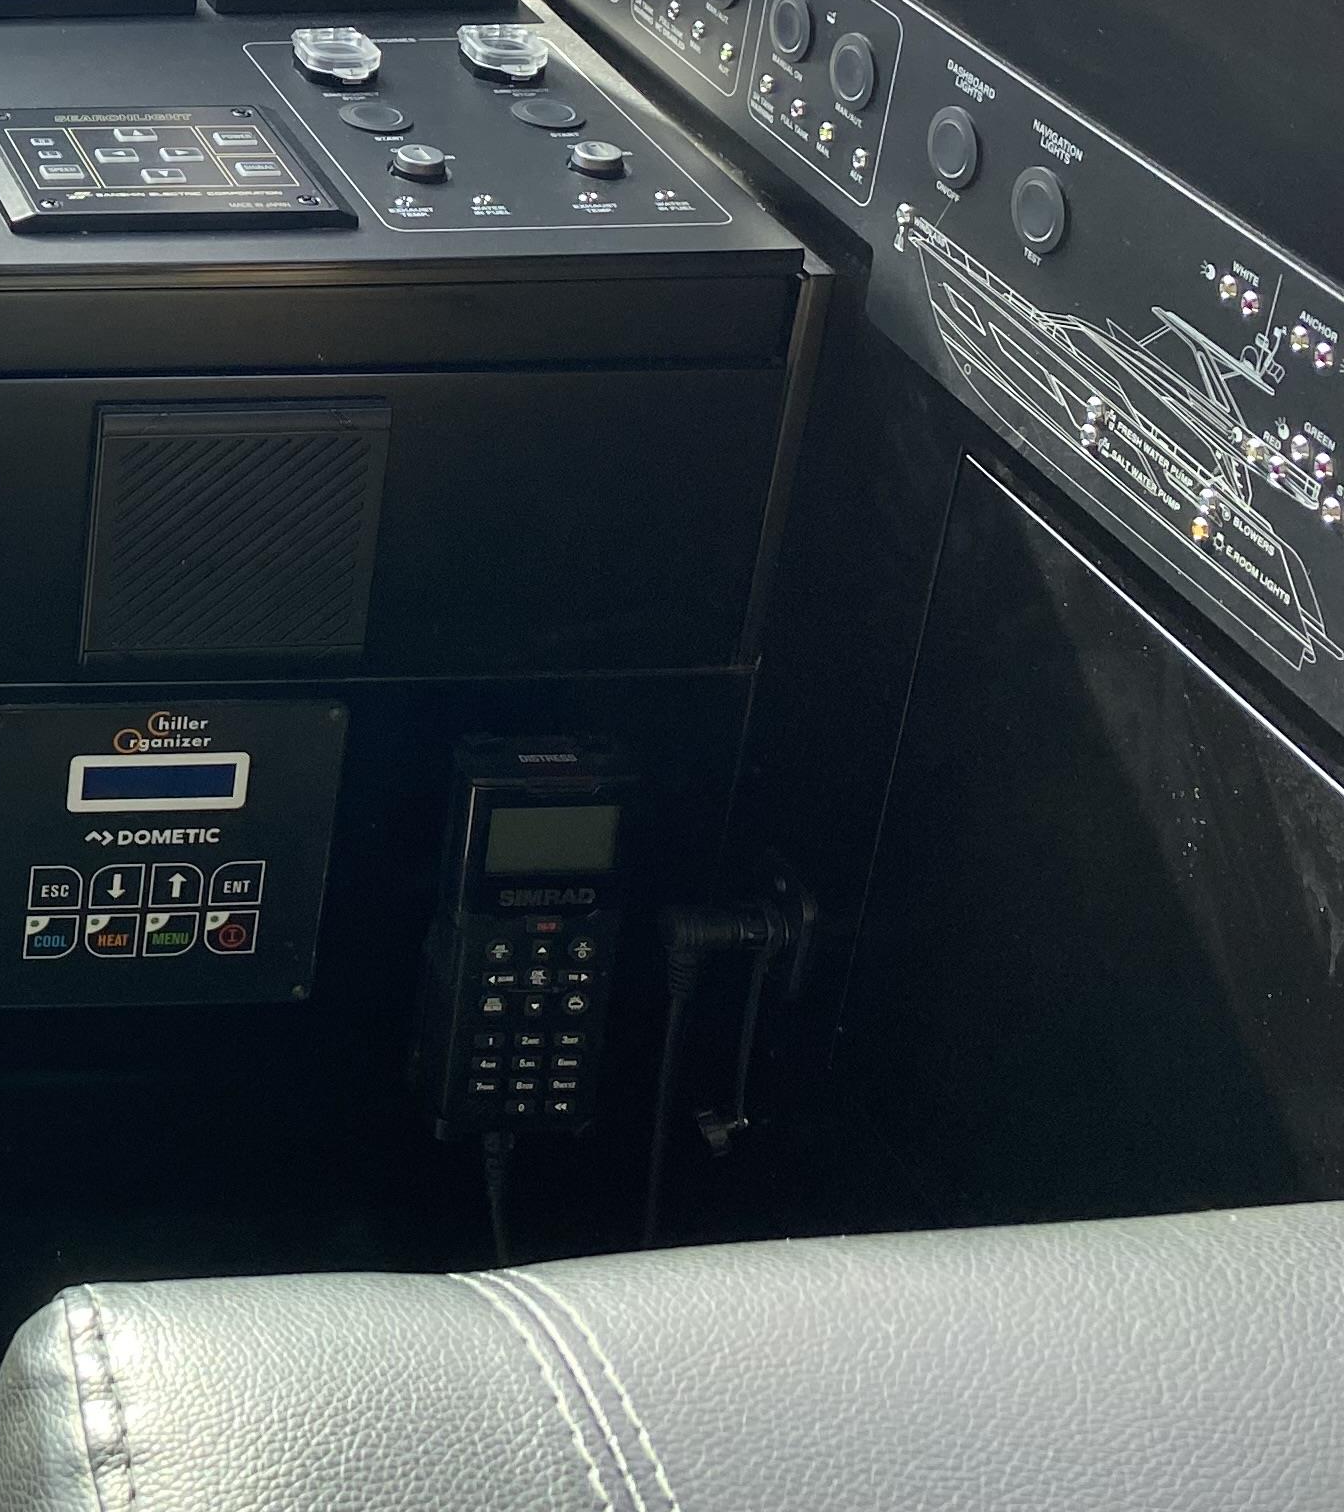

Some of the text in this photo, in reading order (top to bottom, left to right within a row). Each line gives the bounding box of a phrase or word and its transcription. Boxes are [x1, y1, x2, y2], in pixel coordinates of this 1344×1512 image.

[771, 52, 804, 83] MANUAL ON
[946, 58, 997, 100] DASHBOARD
[955, 76, 983, 103] LIGHTS
[53, 113, 193, 123] SEARCHLIGHT
[780, 113, 810, 142] FULL TANK
[1032, 118, 1084, 162] NAVIGATION
[1040, 137, 1071, 165] LIGHTS
[935, 180, 961, 203] ON/OFF
[1023, 246, 1042, 267] TEST
[1232, 260, 1261, 287] WHITE
[1298, 309, 1339, 344] ANCHOR
[1262, 430, 1282, 451] RED
[1303, 421, 1336, 452] GREEN
[1116, 421, 1194, 489] FRESH WATER PUMP
[1110, 449, 1181, 512] SALT WATER PUMP
[1232, 516, 1276, 557] BLOWERS
[1225, 545, 1291, 605] E.ROOM LIGHTS
[147, 711, 209, 737] Chiller
[113, 728, 212, 754] Organizer
[518, 754, 578, 763] DISTRESS
[117, 828, 221, 846] DOMETIC
[40, 884, 70, 898] ESC
[222, 880, 251, 894] ENT
[498, 888, 597, 907] SIMRAD
[33, 934, 68, 948] COOL
[96, 933, 130, 947] HEAT
[151, 931, 190, 945] MENU
[517, 1103, 525, 1112] 0
